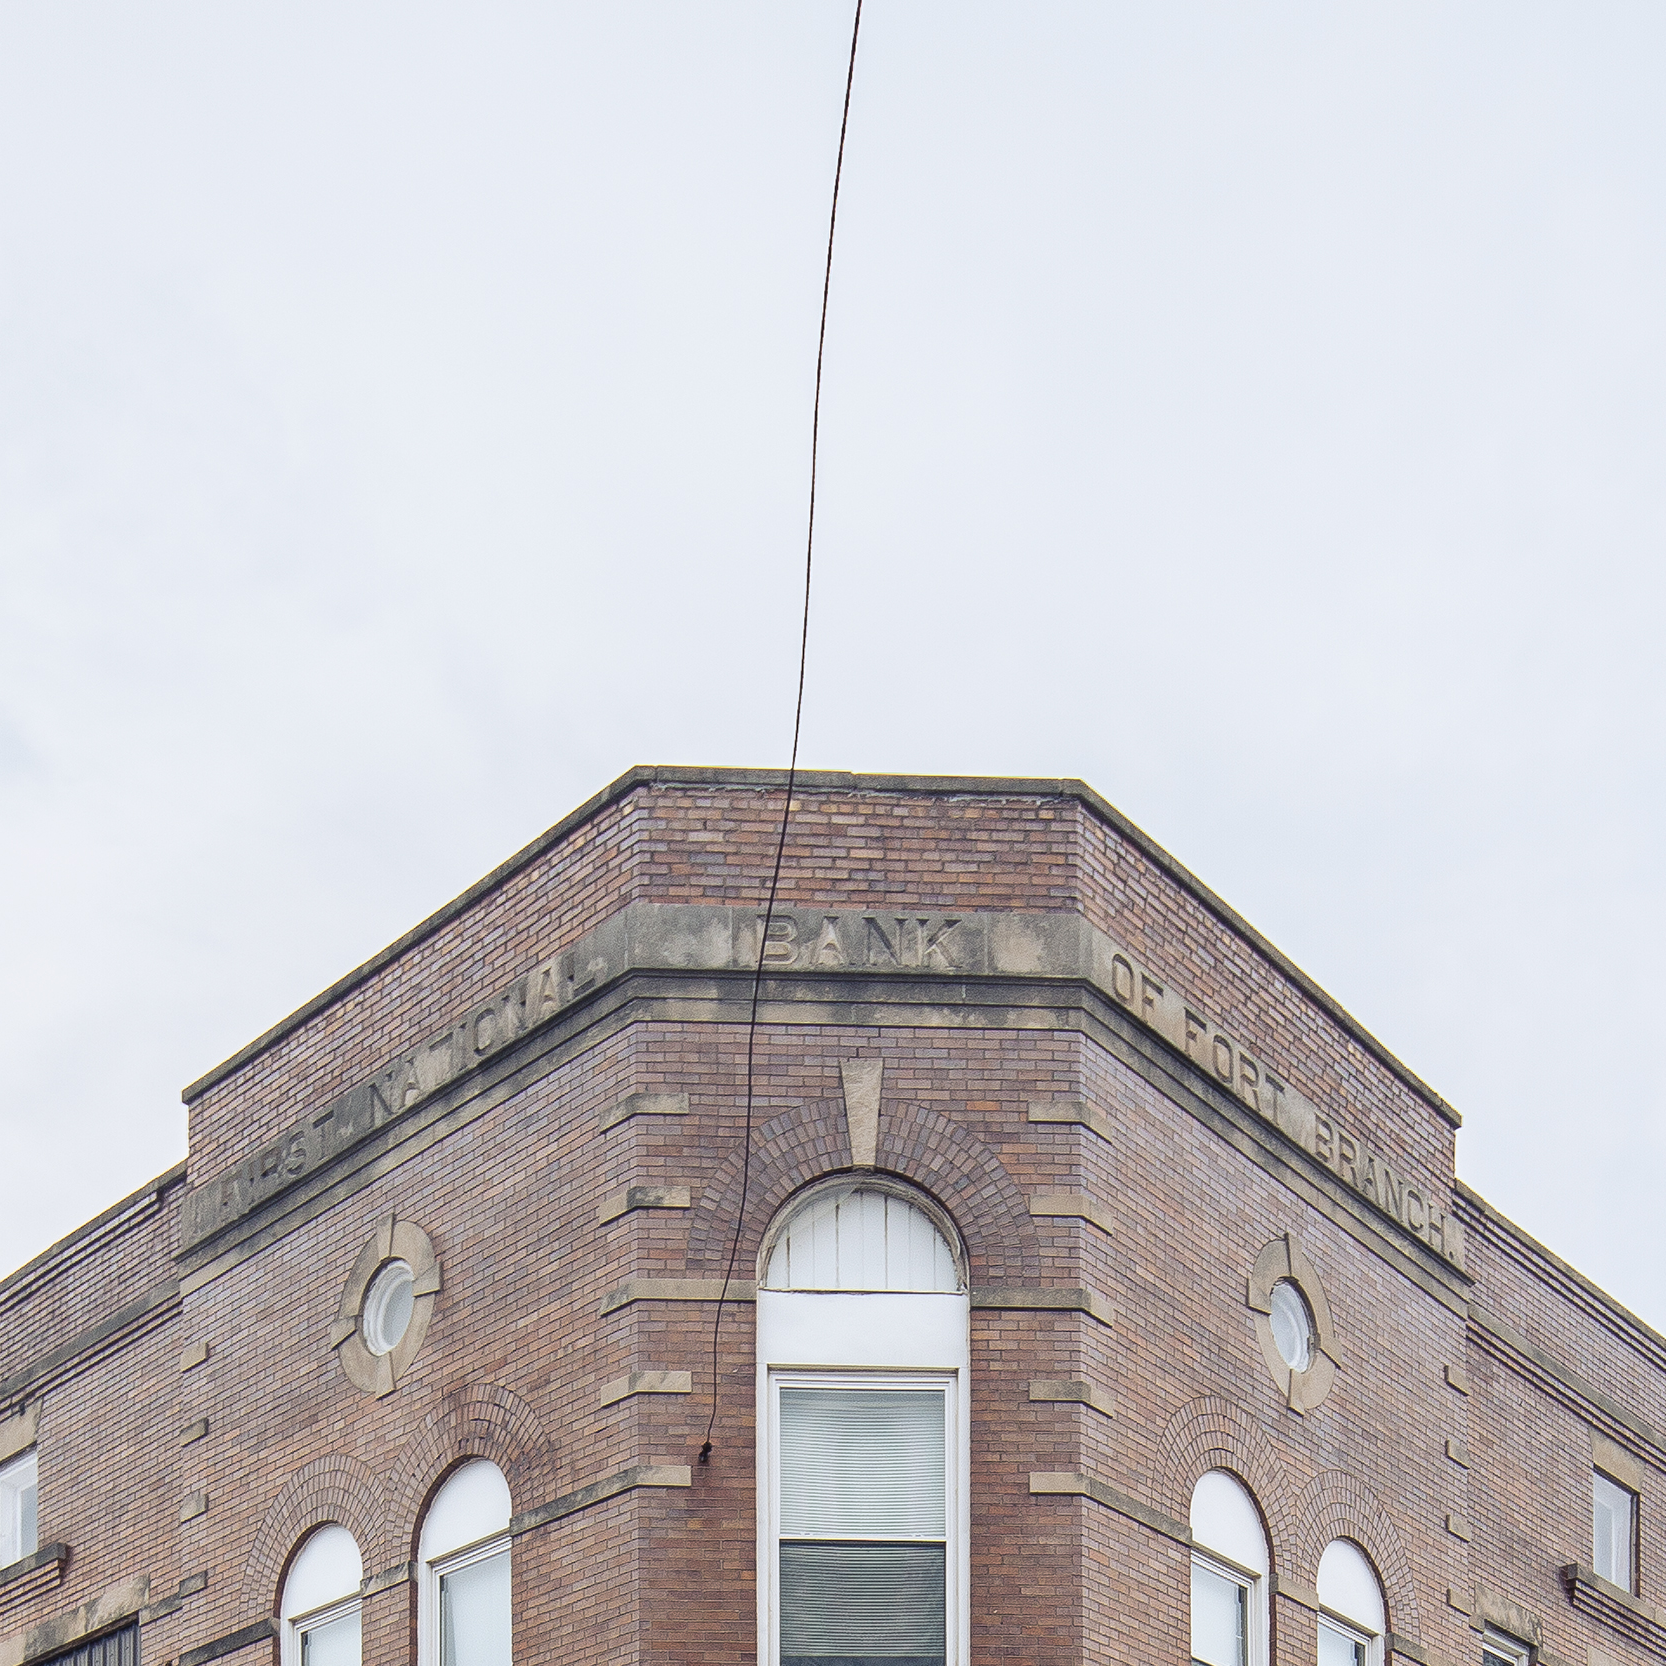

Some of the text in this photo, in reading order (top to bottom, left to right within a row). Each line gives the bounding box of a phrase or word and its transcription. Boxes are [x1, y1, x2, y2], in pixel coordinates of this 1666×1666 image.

[367, 950, 597, 1131] NATIONAL
[755, 913, 963, 970] BANK
[1111, 953, 1165, 1026] OF
[1184, 1006, 1285, 1126] FORT
